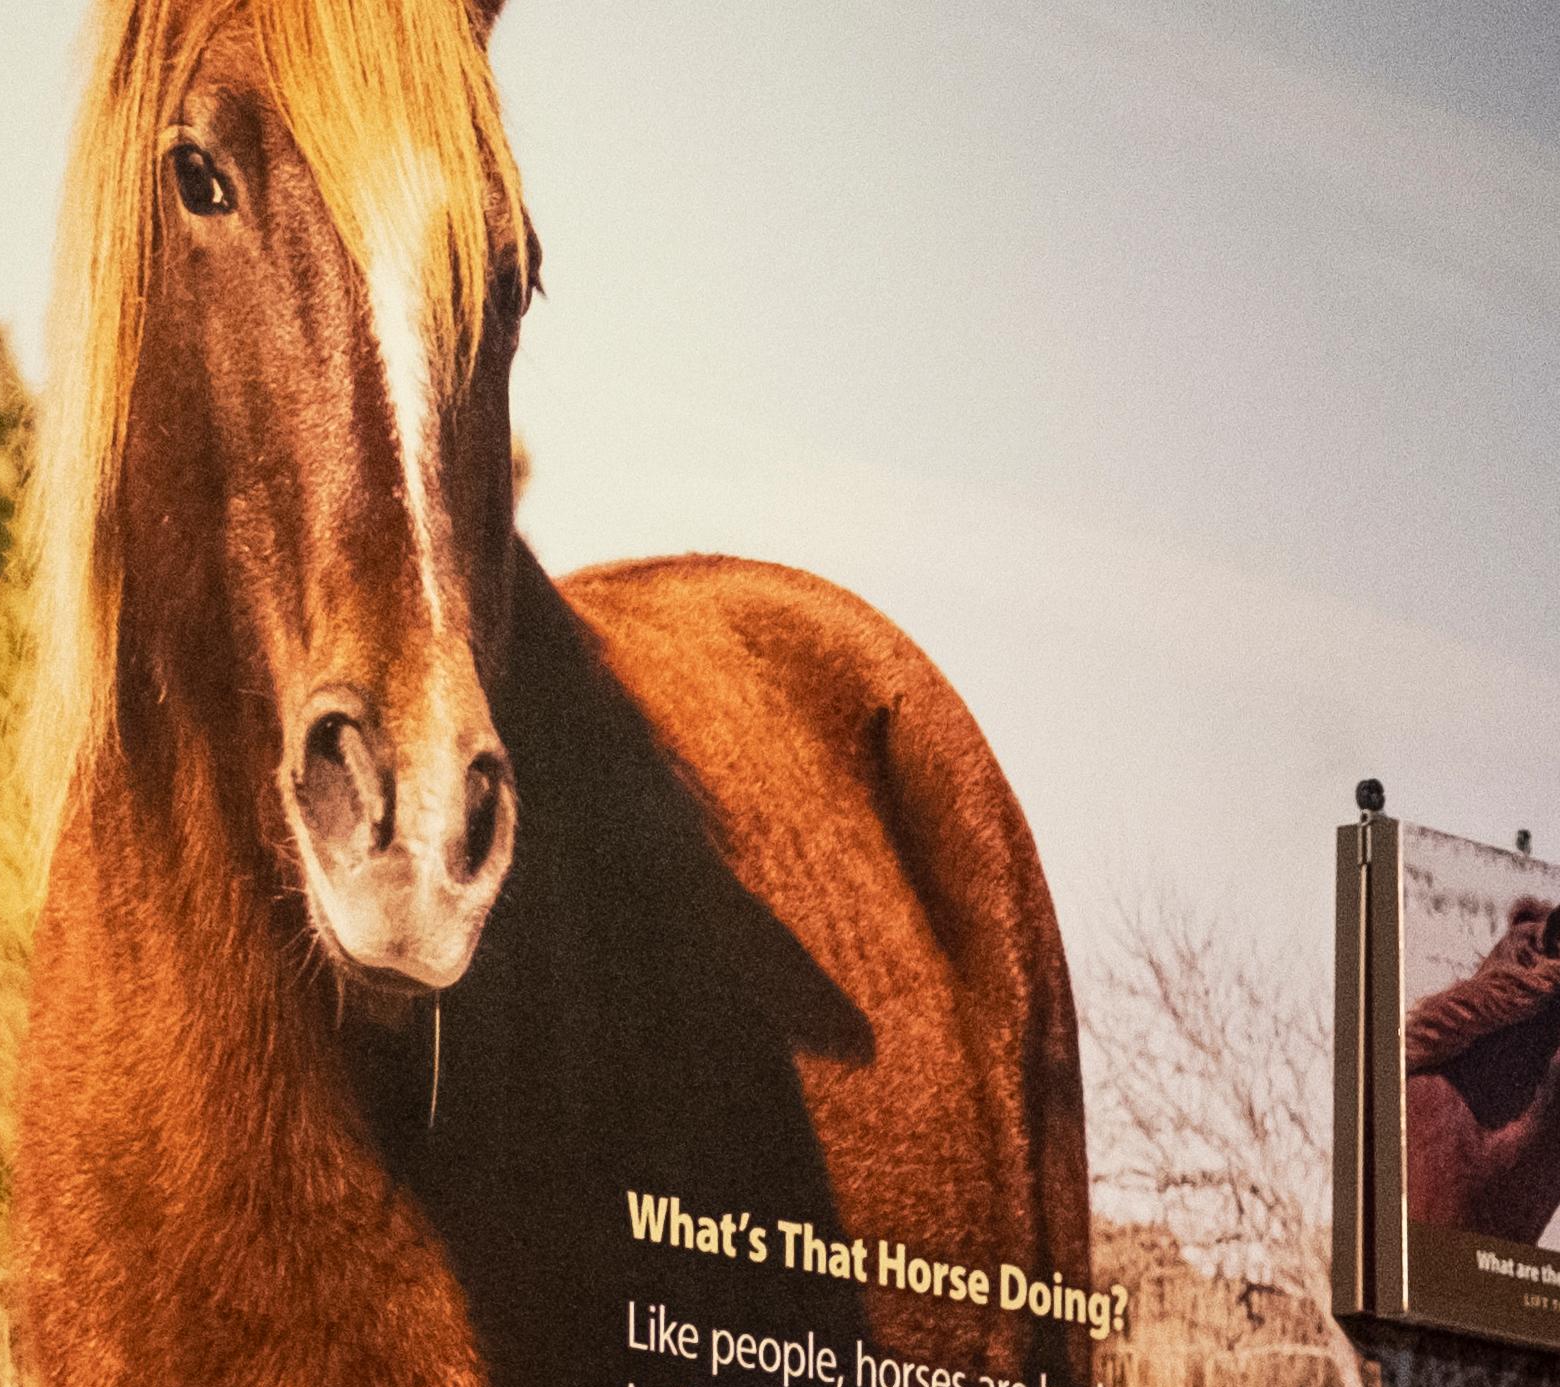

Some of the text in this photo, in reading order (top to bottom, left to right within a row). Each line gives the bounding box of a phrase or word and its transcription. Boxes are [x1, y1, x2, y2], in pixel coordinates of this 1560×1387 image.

[627, 1189, 1128, 1341] What’s That Horse Doing?
[1476, 1249, 1515, 1278] What
[1516, 1262, 1540, 1283] are
[627, 1299, 700, 1361] Like
